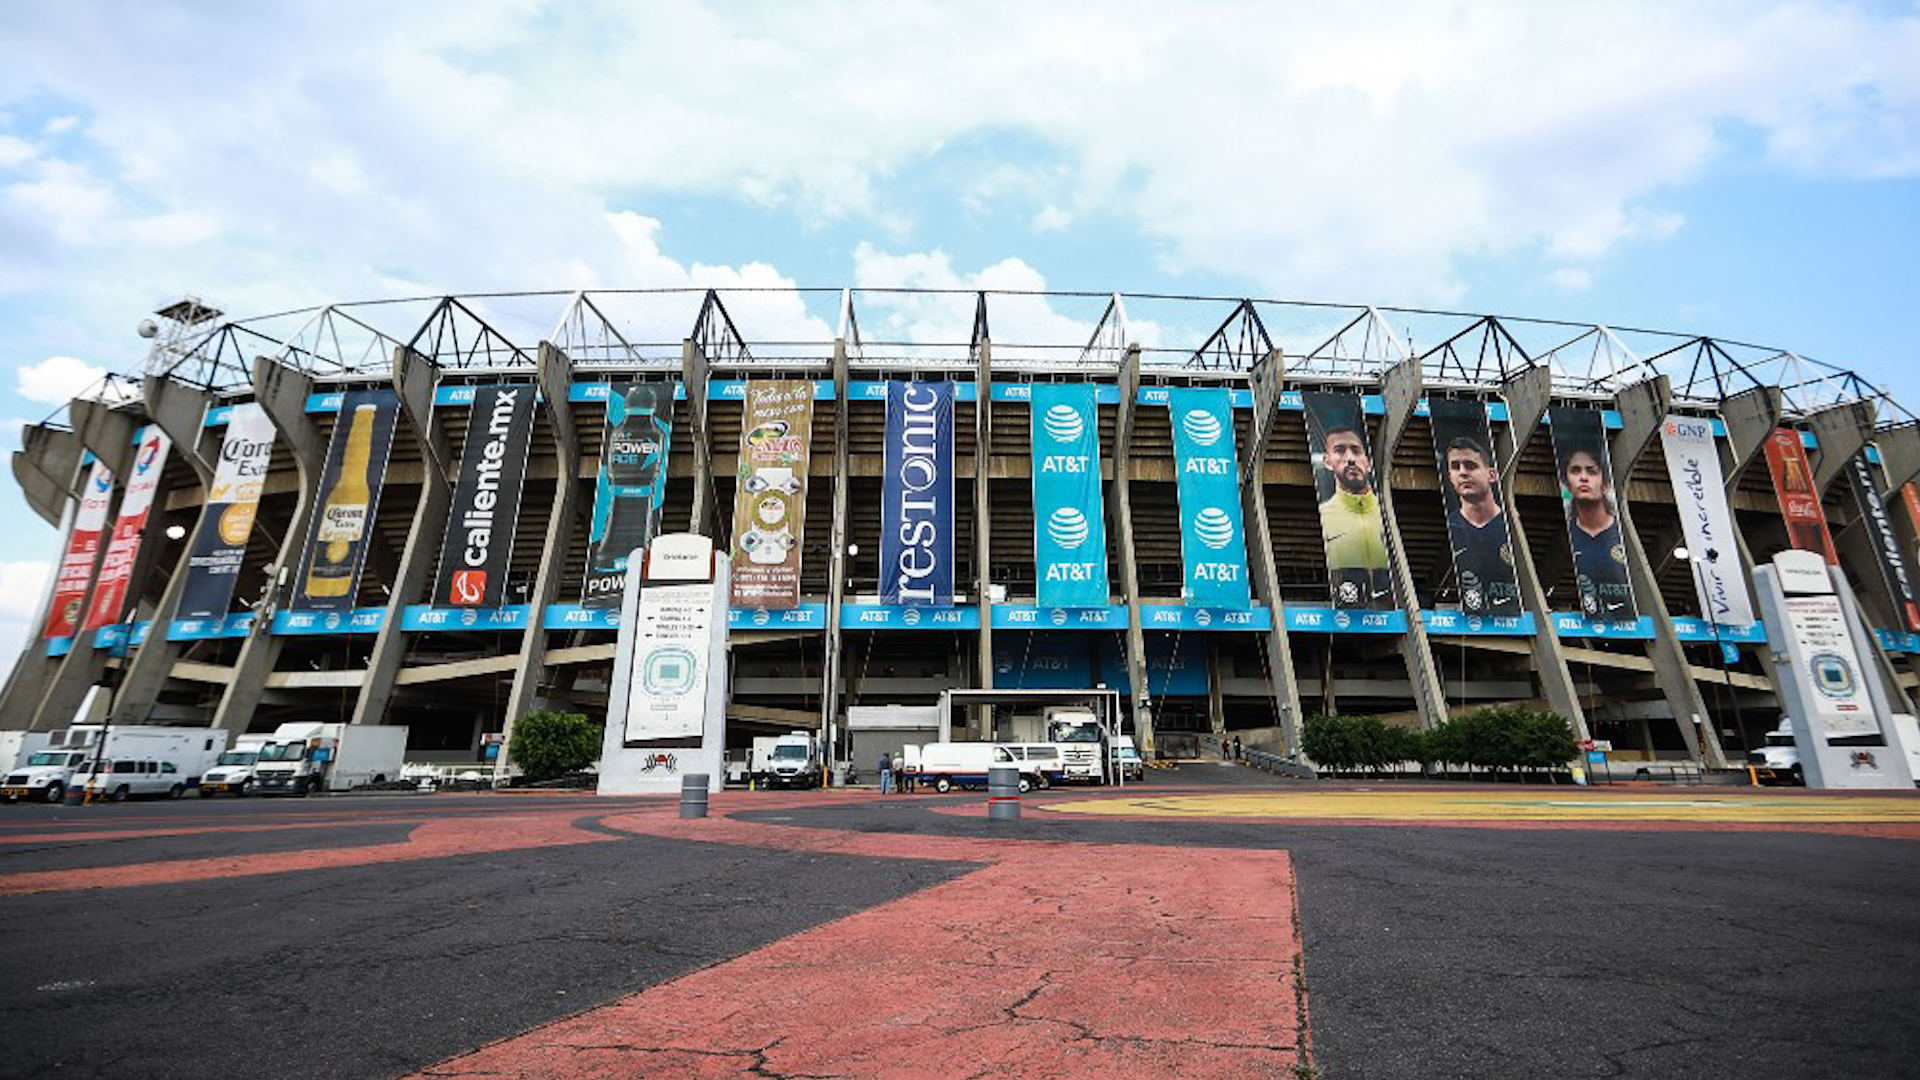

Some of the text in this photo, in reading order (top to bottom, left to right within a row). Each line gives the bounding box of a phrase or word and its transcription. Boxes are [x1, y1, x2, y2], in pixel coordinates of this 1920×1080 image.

[1678, 423, 1706, 437] GNP
[1042, 456, 1090, 473] AT&T
[1185, 457, 1231, 475] AT&T
[463, 389, 518, 567] caliente.mx
[1046, 563, 1095, 581] AT&T
[1194, 563, 1239, 581] AT&T
[418, 612, 449, 624] AT&T
[489, 611, 520, 623] AT&T
[564, 610, 597, 622] AT&T
[782, 611, 814, 622] AT&T
[860, 610, 890, 622] AT&T
[933, 611, 964, 622] AT&T
[1008, 610, 1037, 622] AT&T
[1080, 611, 1110, 622] AT&T
[1154, 611, 1183, 622] AT&T
[1223, 612, 1252, 623] AT&T
[1295, 614, 1323, 626] AT&T
[1362, 614, 1389, 626] AT&T
